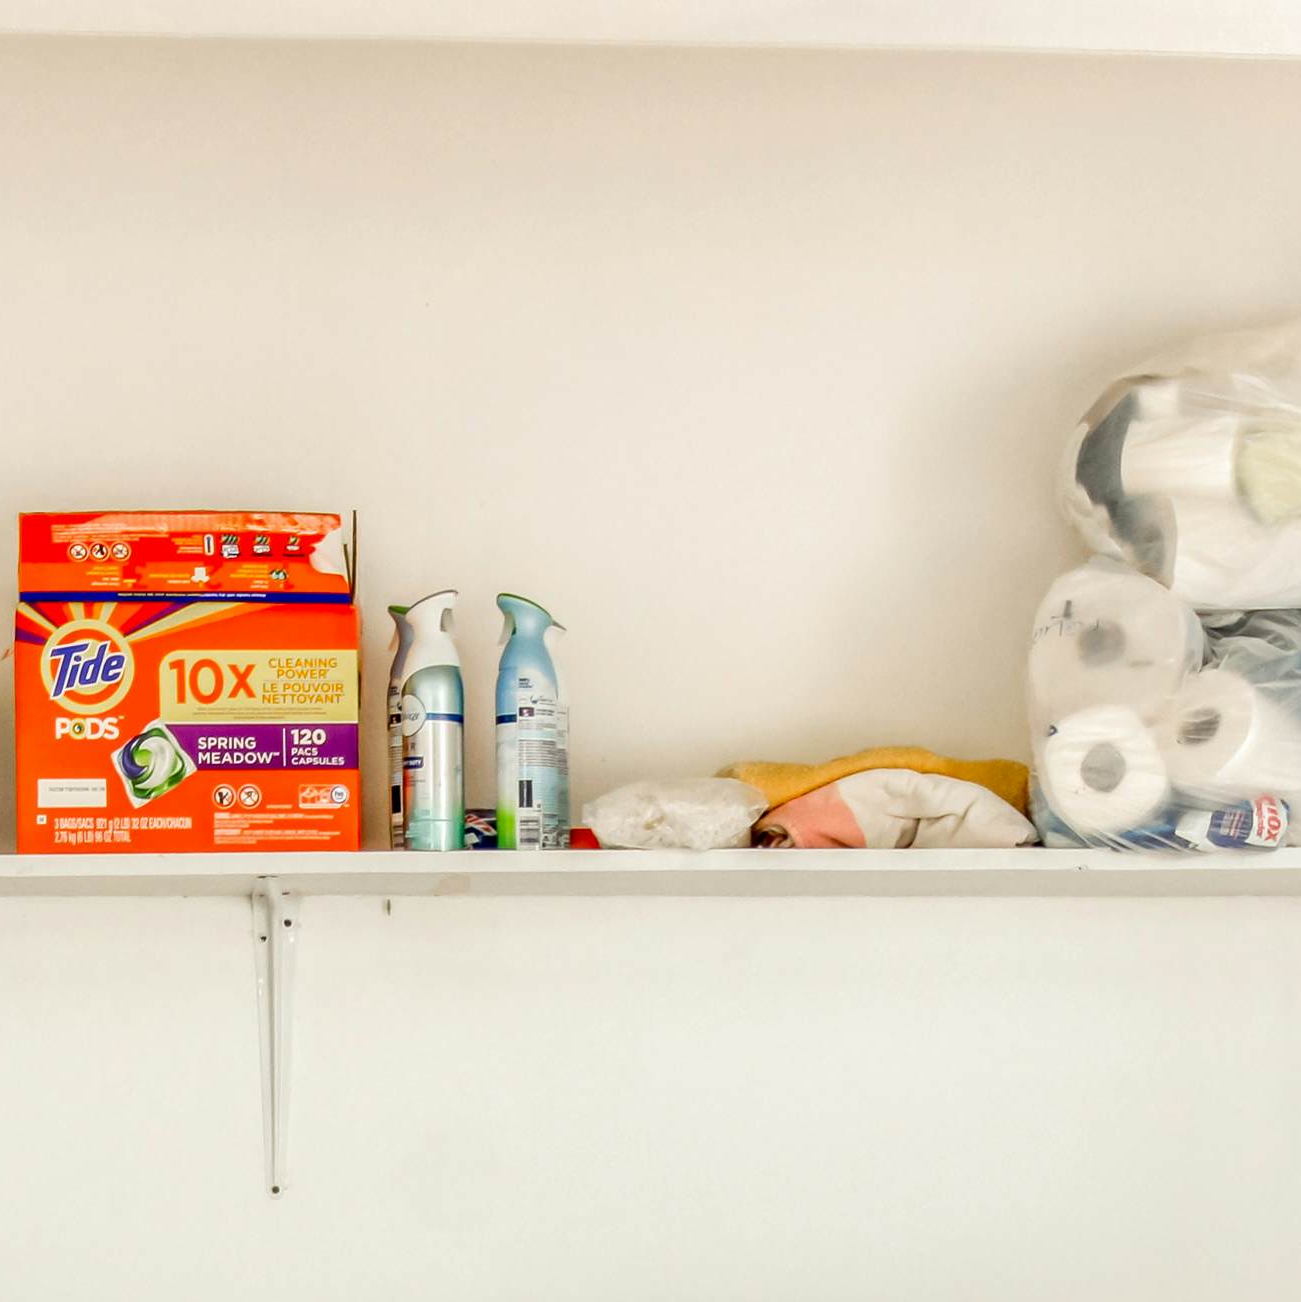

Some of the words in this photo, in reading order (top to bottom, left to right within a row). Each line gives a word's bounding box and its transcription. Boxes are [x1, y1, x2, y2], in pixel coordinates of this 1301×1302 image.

[268, 657, 338, 668] CLEANING
[50, 641, 126, 699] Tide
[276, 669, 327, 679] POWER
[262, 683, 278, 693] LE
[282, 683, 344, 693] POUVOIR
[261, 694, 342, 704] NETTOYANT
[55, 718, 119, 740] PODS
[290, 729, 327, 745] 120
[198, 737, 257, 750] SPRING
[291, 747, 319, 756] PACS
[198, 752, 273, 765] MEADOW
[291, 756, 345, 766] CAPSULES
